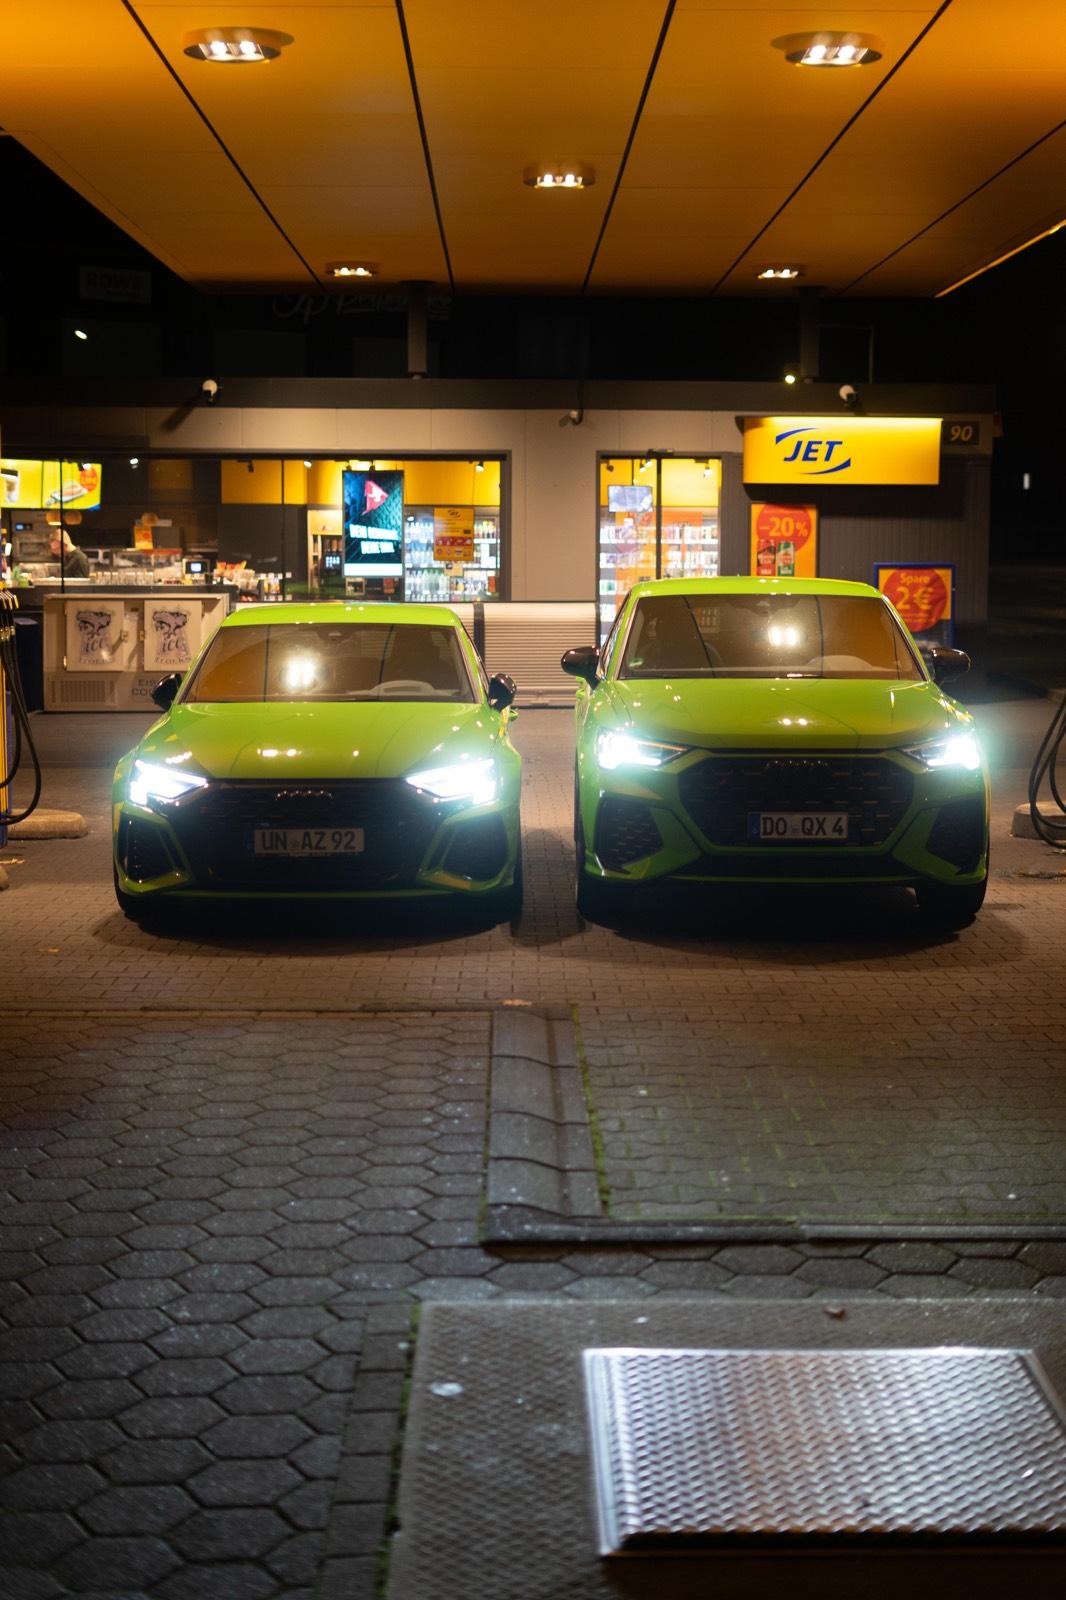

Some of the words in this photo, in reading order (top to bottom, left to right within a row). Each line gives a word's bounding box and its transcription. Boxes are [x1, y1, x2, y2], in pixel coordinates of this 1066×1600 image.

[950, 425, 974, 441] 90
[783, 441, 843, 462] JET
[900, 573, 930, 586] Spare
[762, 816, 787, 836] DO
[801, 816, 827, 836] QX
[832, 816, 845, 836] 4
[261, 831, 287, 851] UN
[302, 831, 327, 851] AZ
[331, 831, 356, 851] 92
